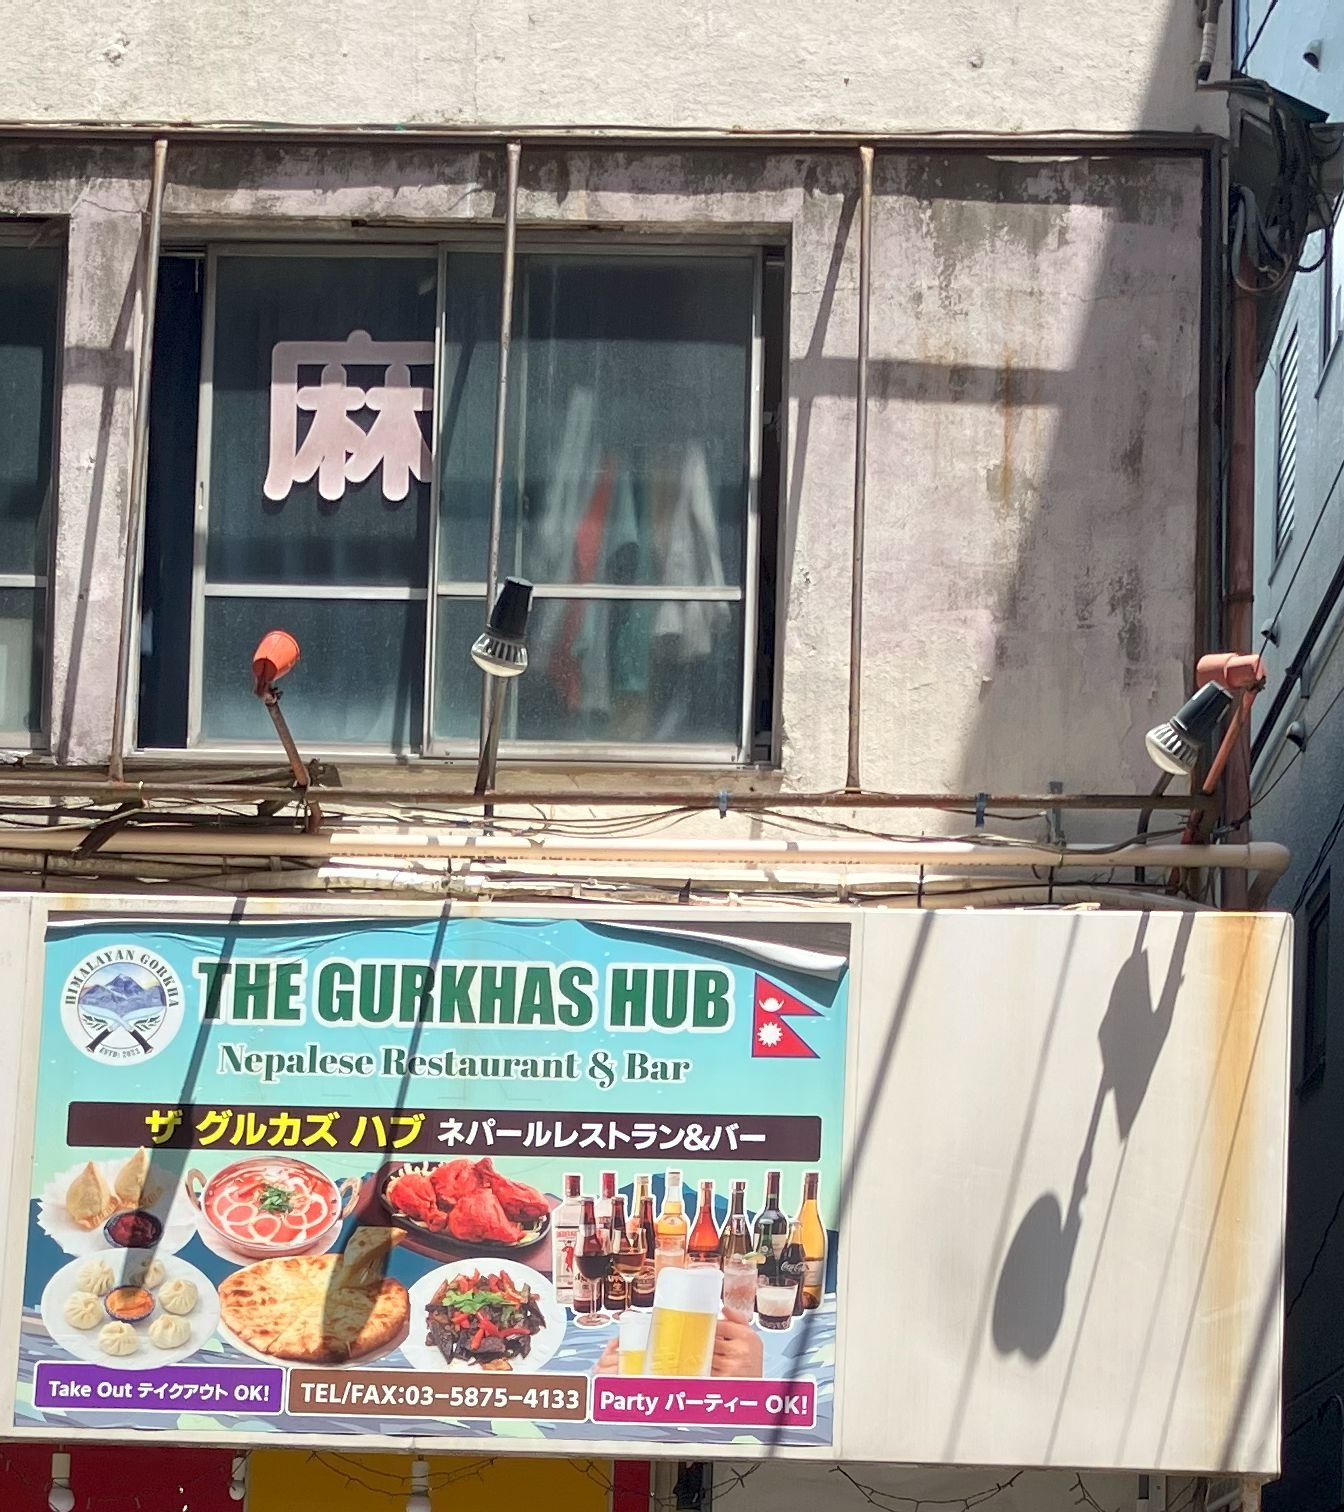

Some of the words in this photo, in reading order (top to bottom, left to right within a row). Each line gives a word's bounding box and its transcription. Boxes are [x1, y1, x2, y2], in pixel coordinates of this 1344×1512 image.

[263, 329, 434, 501] 麻
[65, 949, 136, 1005] HIMALAYAN
[140, 954, 180, 1008] GORKHA
[198, 962, 303, 1021] THE
[318, 963, 594, 1028] GURKHAS
[610, 968, 731, 1029] HUB
[220, 1044, 374, 1083] Nepalese
[382, 1046, 579, 1080] Restaurant
[587, 1050, 615, 1090] &
[626, 1052, 691, 1082] Bar
[145, 1109, 184, 1144] ザ
[196, 1109, 342, 1148] グルカズ
[350, 1113, 427, 1150] ハブ
[437, 1118, 767, 1152] ネパールレストラン&バー
[48, 1380, 92, 1398] Take
[97, 1382, 133, 1399] Out
[137, 1382, 229, 1402] テイクアウト
[234, 1384, 270, 1402] OK!
[301, 1381, 580, 1410] TEL/FAX:03-5875-4133
[600, 1391, 659, 1417] Party
[665, 1391, 758, 1414] パーティー
[765, 1394, 808, 1416] OK!
